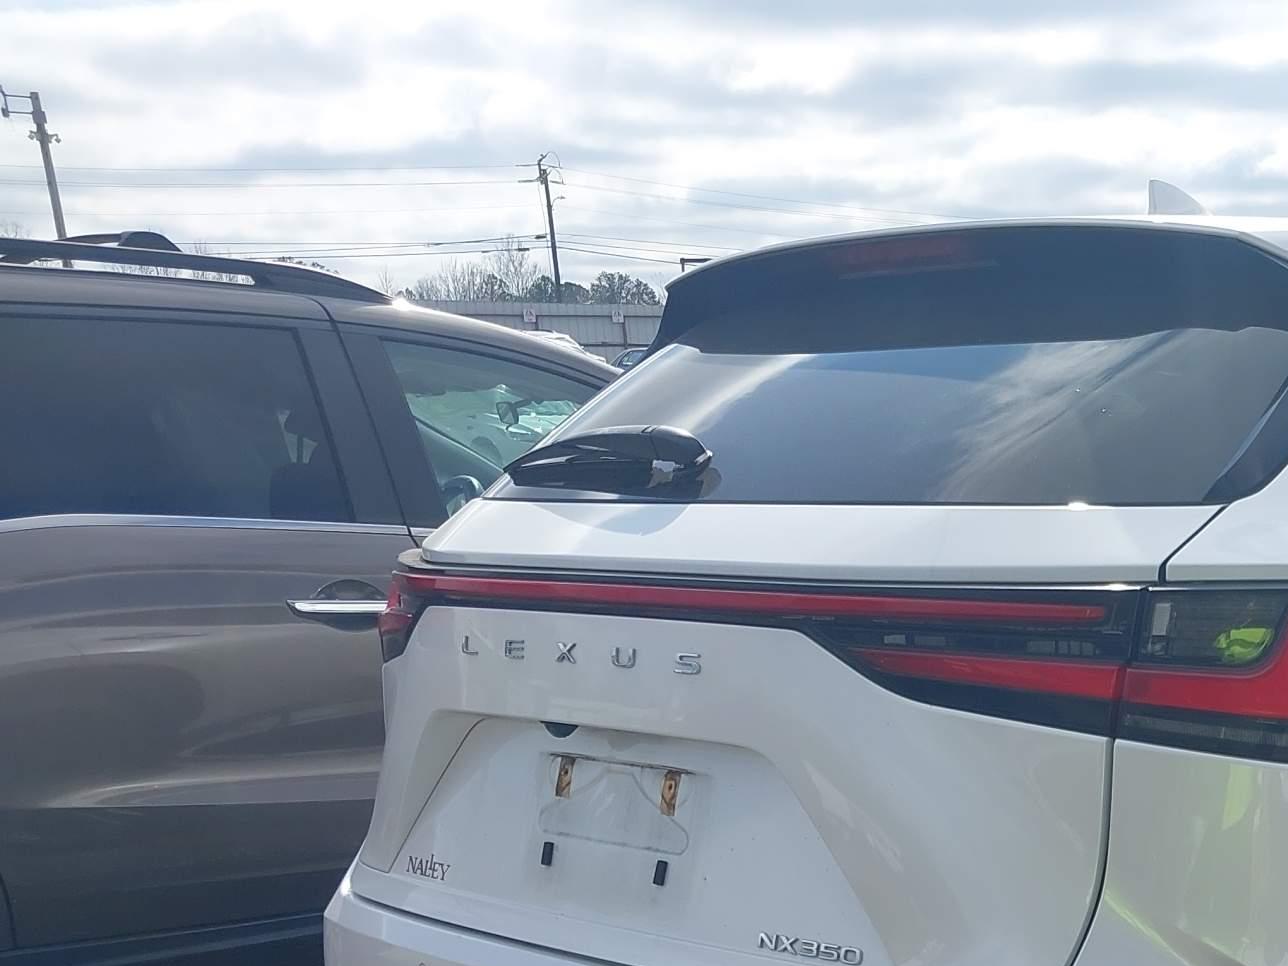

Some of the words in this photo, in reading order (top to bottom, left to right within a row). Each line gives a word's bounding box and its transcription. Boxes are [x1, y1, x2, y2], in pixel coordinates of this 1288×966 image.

[461, 635, 701, 675] LEXUS
[406, 853, 451, 881] NALLEY
[758, 931, 864, 966] NX350
